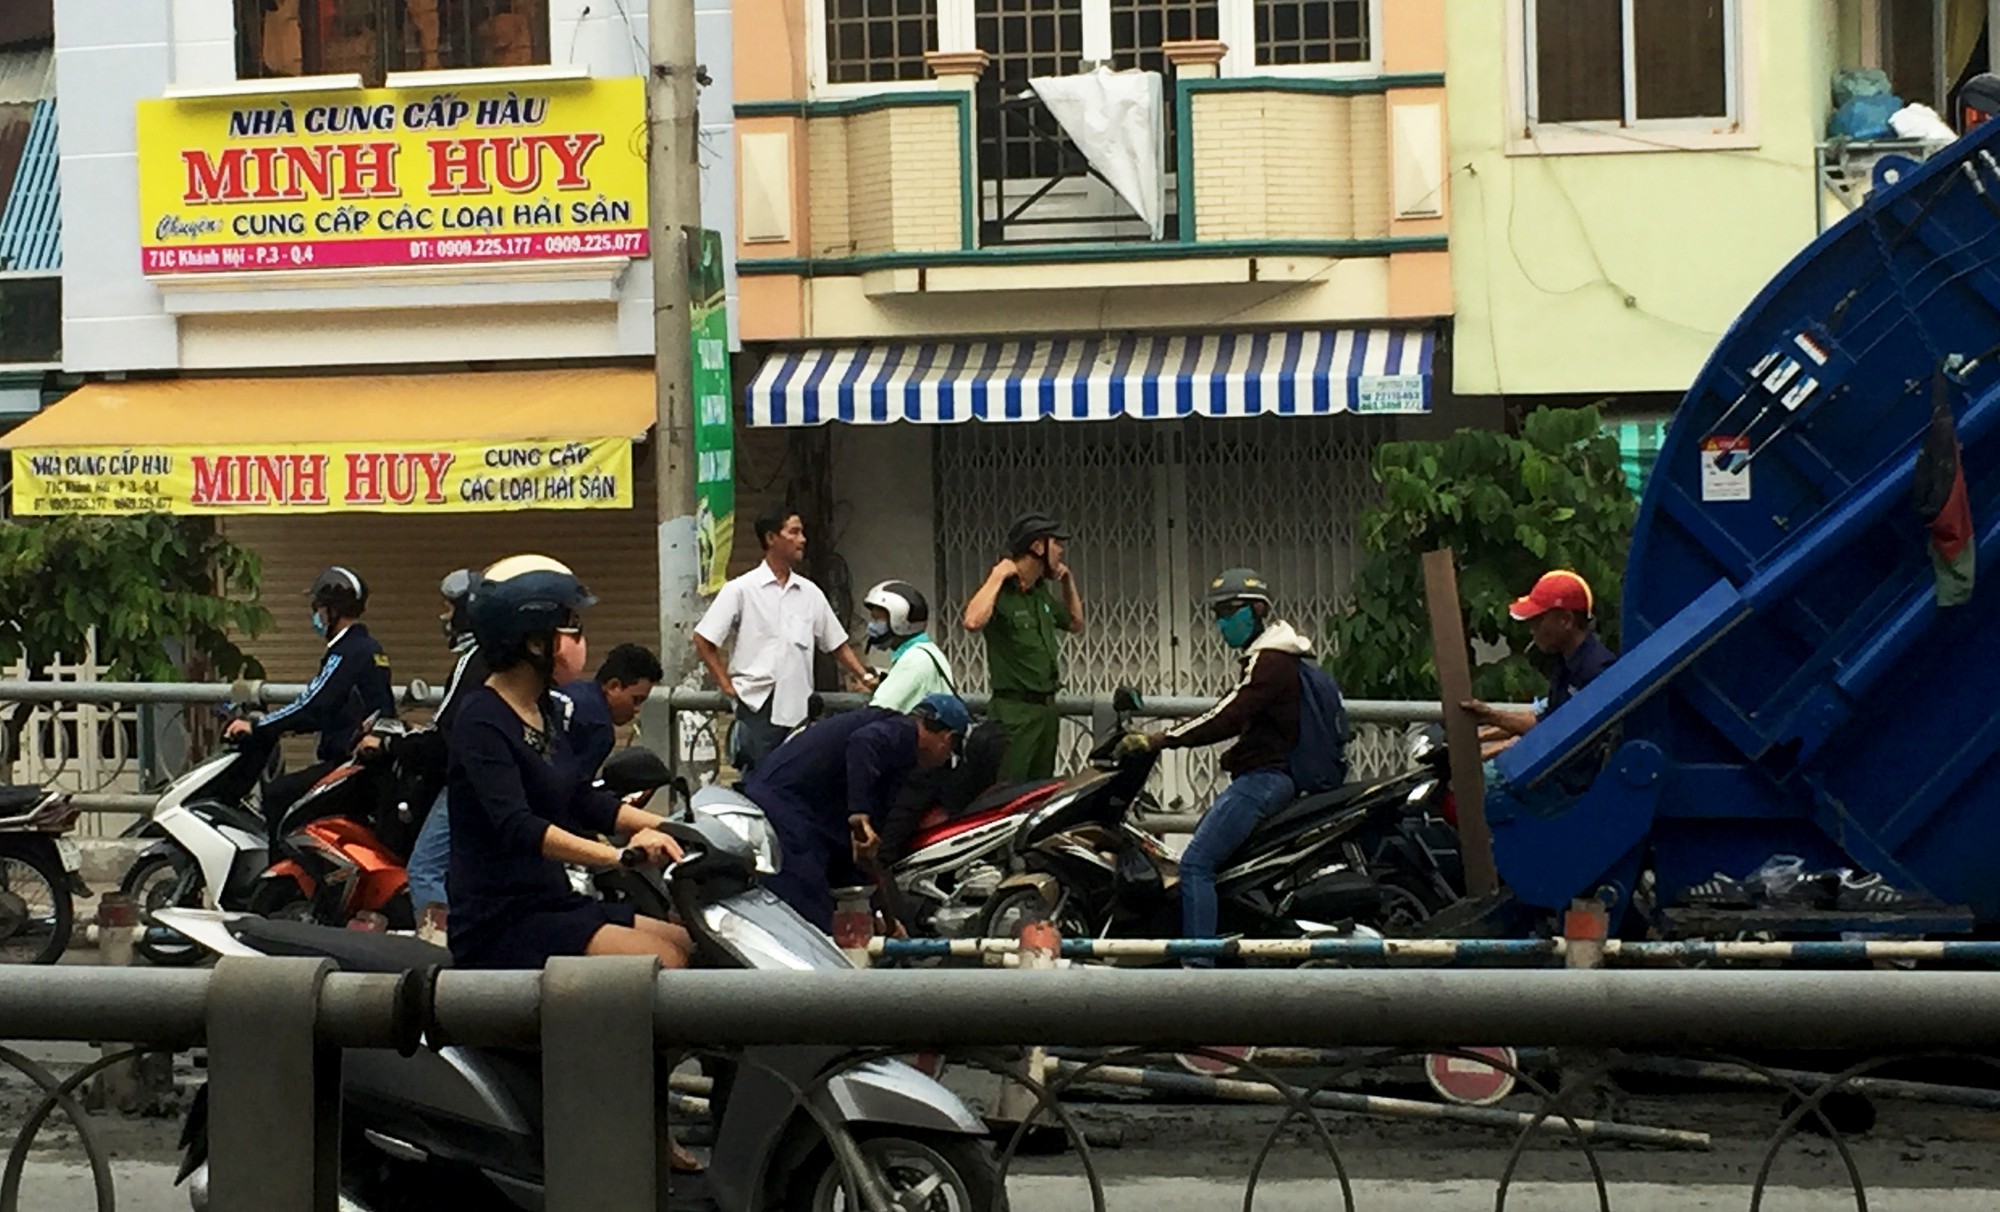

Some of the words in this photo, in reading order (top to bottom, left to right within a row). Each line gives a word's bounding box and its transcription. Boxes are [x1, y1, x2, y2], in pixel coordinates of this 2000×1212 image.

[230, 101, 296, 135] NHÀ
[304, 104, 395, 133] CUNG
[403, 92, 468, 129] CẤP
[475, 91, 546, 126] HÀU
[182, 142, 400, 205] MINH
[427, 133, 602, 196] HUY
[233, 213, 304, 235] CUNG
[315, 206, 370, 234] CẤP
[378, 204, 432, 232] CÁC
[442, 206, 503, 234] LOẠI
[514, 197, 561, 225] HẢI
[572, 194, 629, 223] SẢN
[150, 250, 176, 267] 71C
[179, 249, 219, 266] Khánh
[223, 248, 245, 267] Hội
[256, 247, 279, 264] P.3
[291, 246, 313, 264] Q.4
[65, 455, 106, 475] CUNG
[109, 448, 139, 475] CẤP
[485, 448, 541, 467] CUNG
[549, 442, 591, 466] CẤP
[190, 454, 330, 506] MINH
[344, 451, 456, 504] HUY
[460, 472, 495, 501] CÁC
[544, 468, 574, 500] HẢI
[580, 466, 615, 499] SẢN
